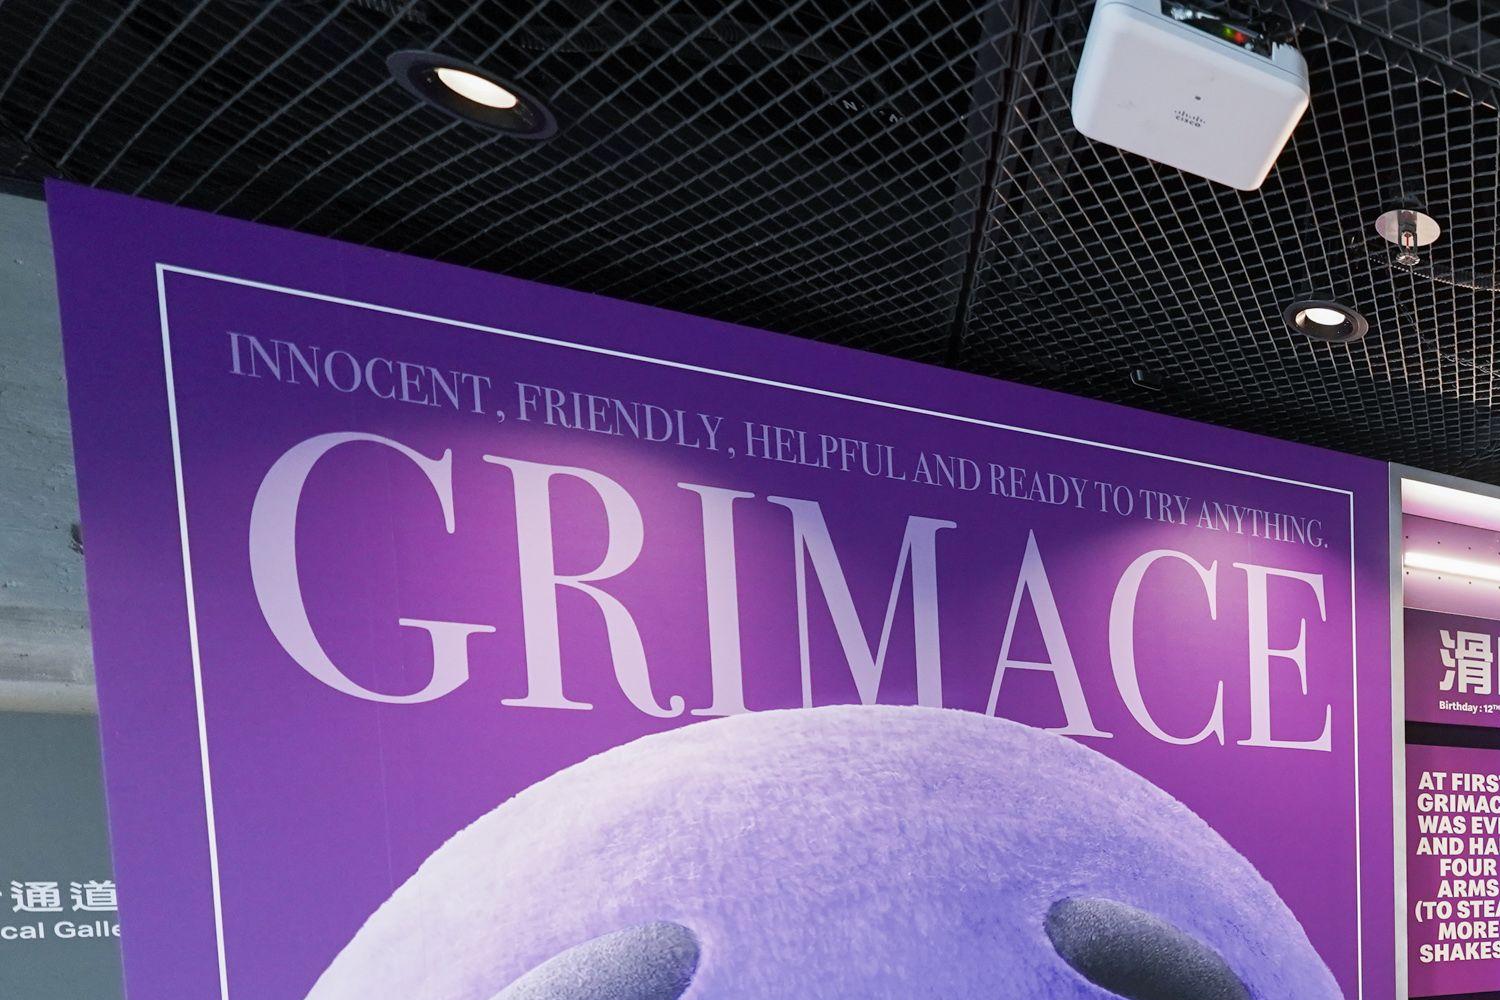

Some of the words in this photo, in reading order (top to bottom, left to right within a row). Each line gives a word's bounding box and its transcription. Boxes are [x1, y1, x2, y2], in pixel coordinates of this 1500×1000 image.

[225, 331, 506, 422] INNOCENT,
[516, 381, 736, 459] FRIENDLY,
[745, 421, 906, 482] HELPFUL
[912, 452, 982, 492] AND
[988, 462, 1088, 509] READY
[1094, 481, 1135, 517] TO
[1139, 489, 1191, 525] TRY
[1197, 501, 1329, 550] ANYTHING.
[249, 432, 1332, 752] GRIMACE
[1418, 771, 1447, 791] AT
[1418, 815, 1467, 835] WAS
[1416, 837, 1465, 856] AND
[1439, 858, 1498, 877] FOUR
[0, 879, 119, 912] 通道
[1437, 879, 1500, 898] ARMS
[1415, 900, 1453, 922] (TO
[1438, 920, 1499, 941] MORE
